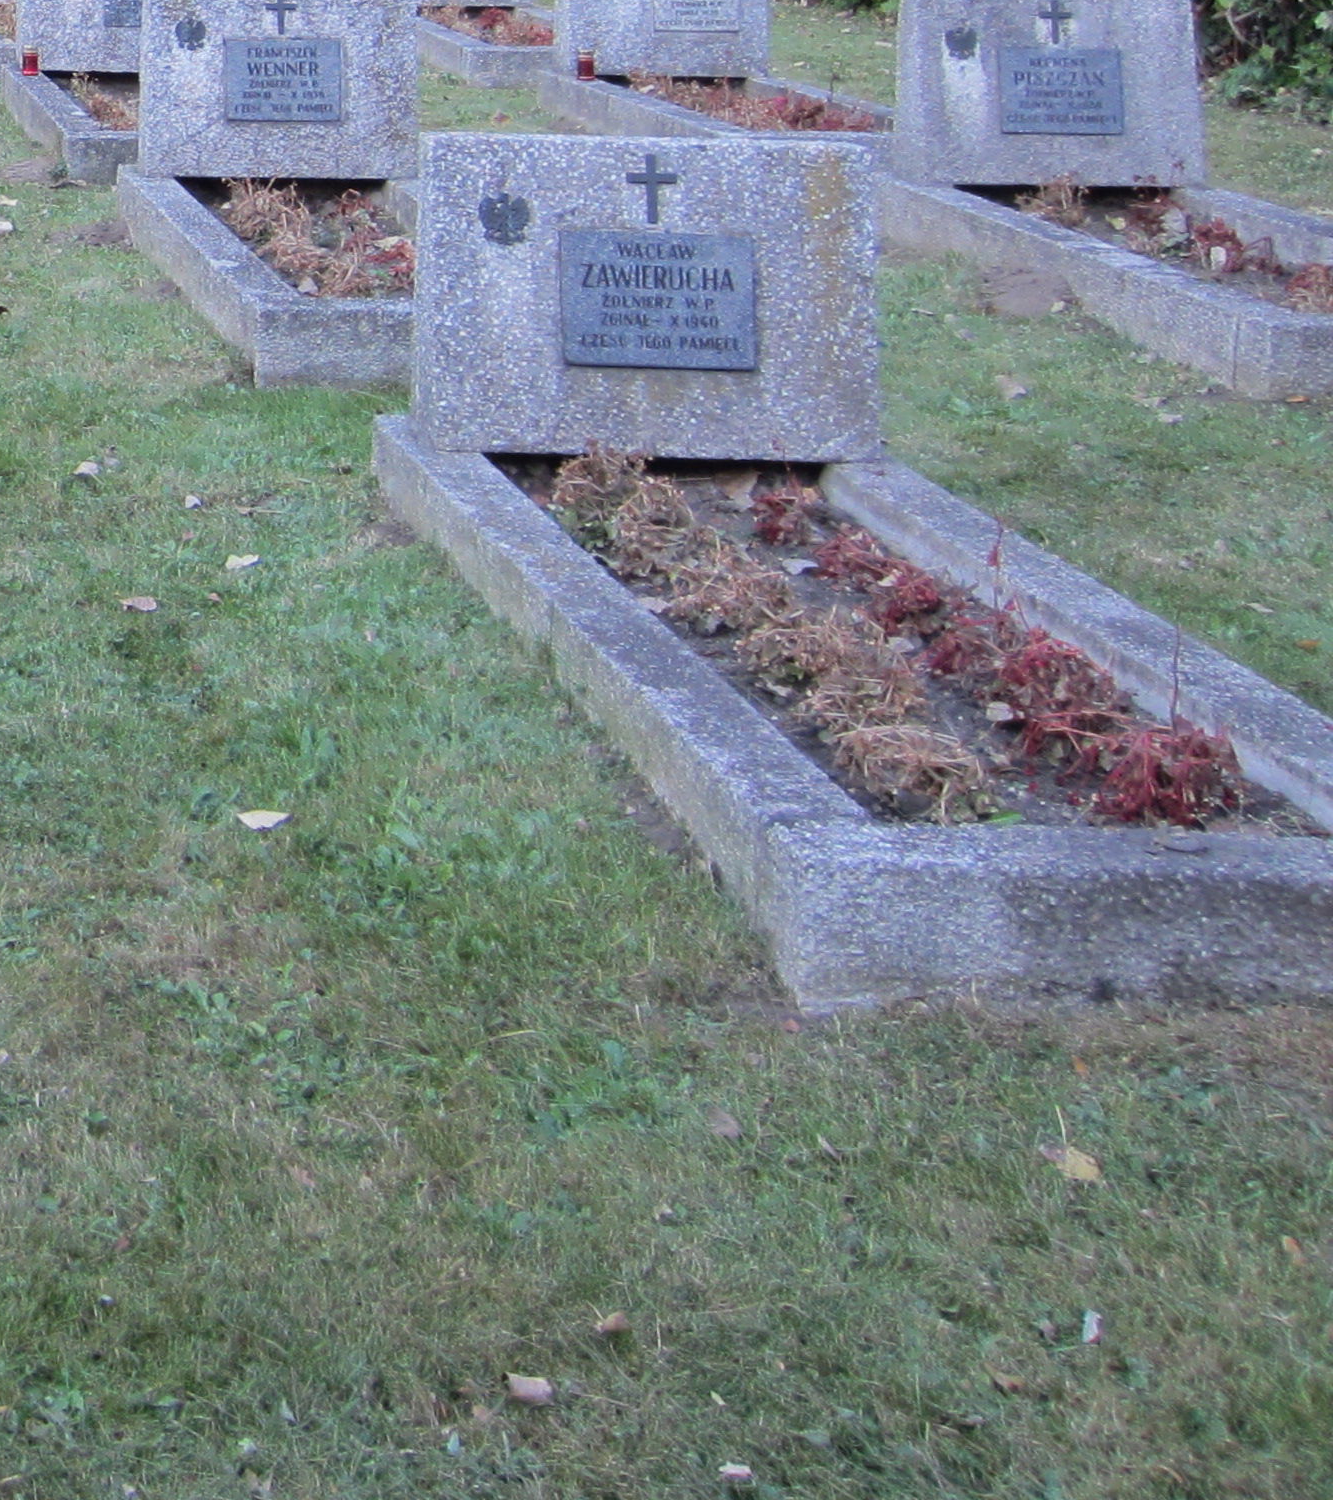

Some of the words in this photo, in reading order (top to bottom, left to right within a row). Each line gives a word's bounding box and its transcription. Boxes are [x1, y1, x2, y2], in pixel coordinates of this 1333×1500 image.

[246, 61, 320, 77] WENNER
[616, 242, 696, 260] WACŁAW
[580, 262, 736, 293] ZAWIERUCHA
[637, 335, 672, 351] JEGO
